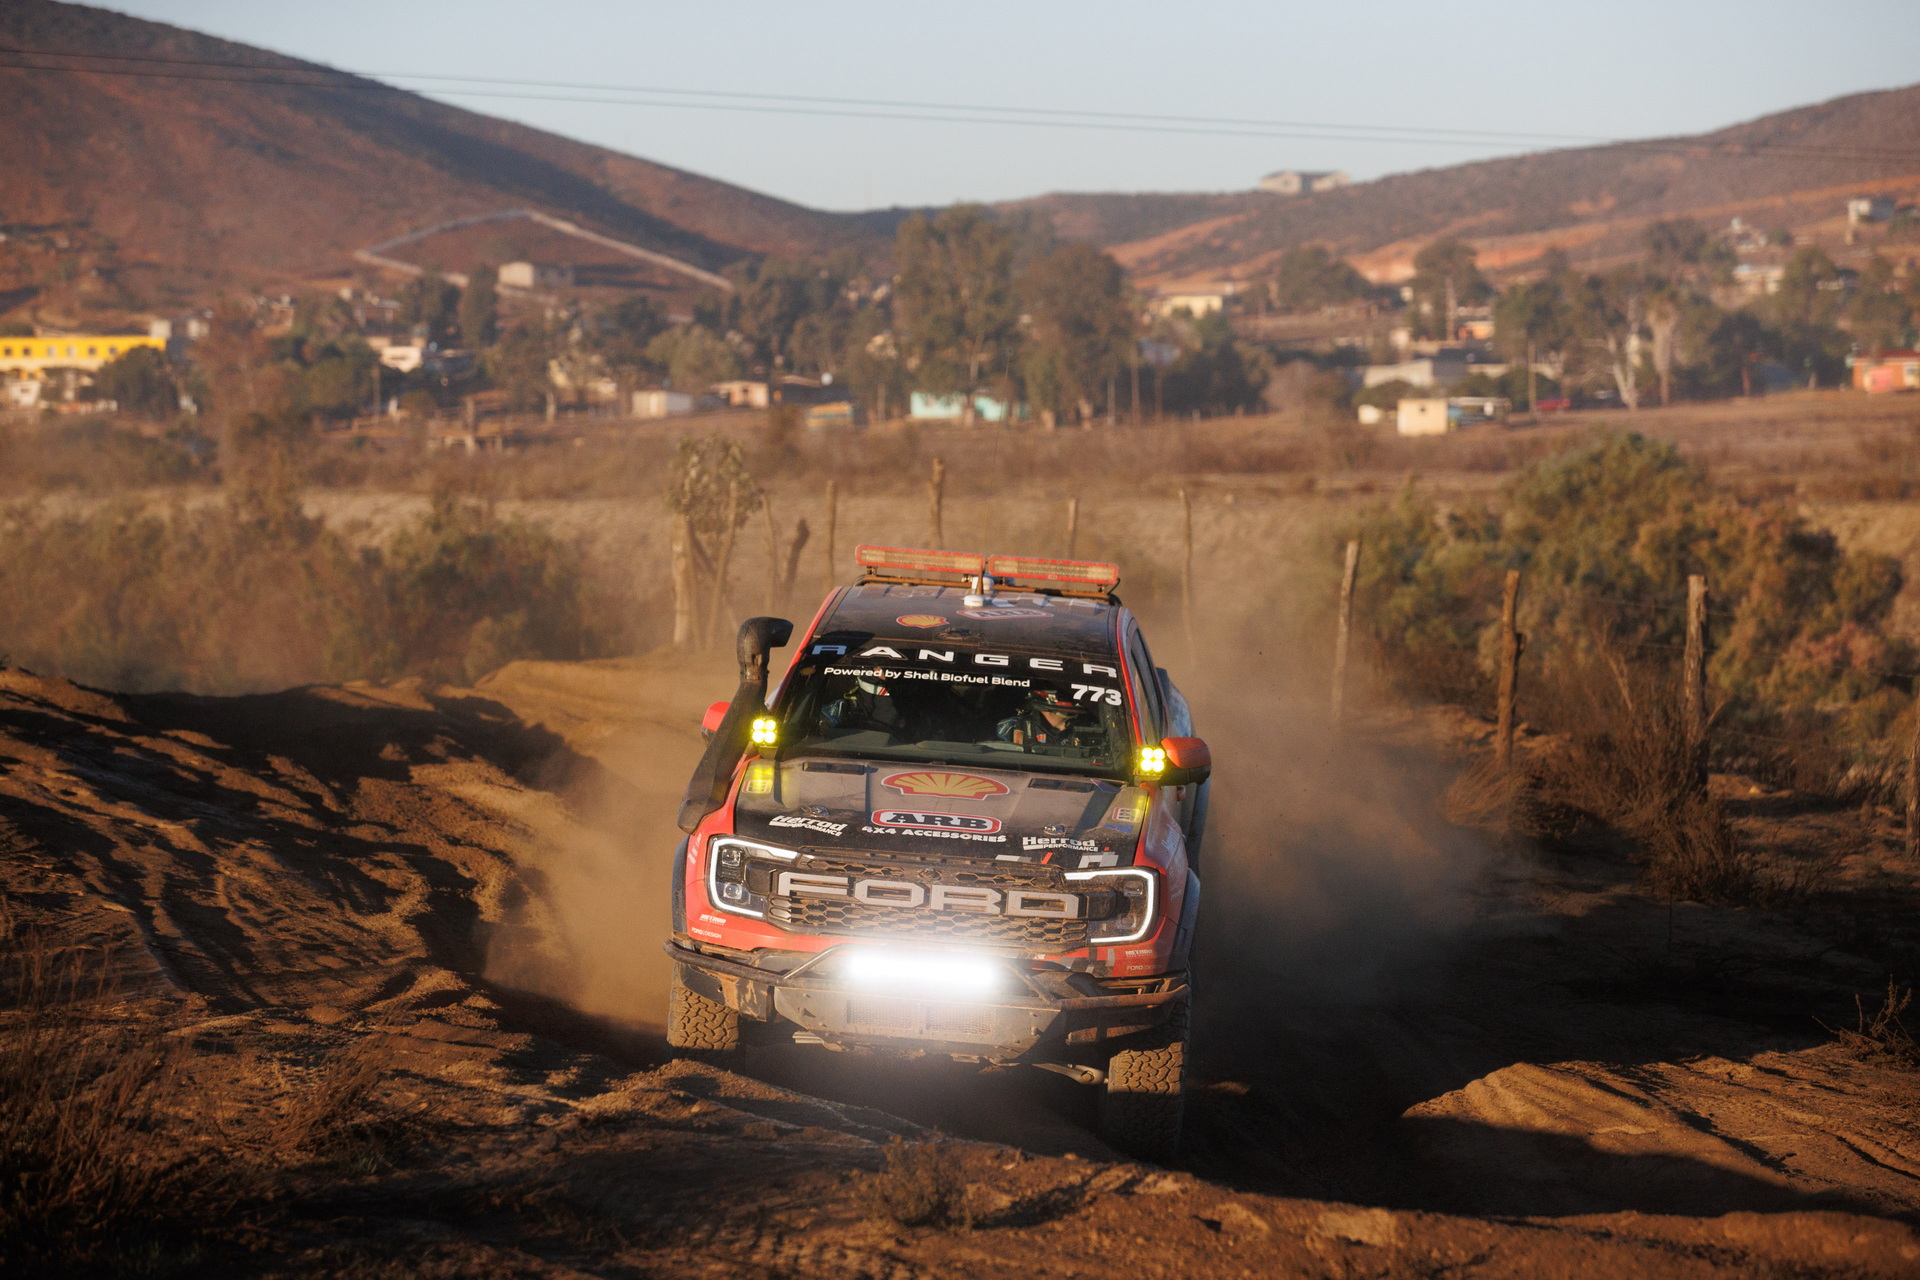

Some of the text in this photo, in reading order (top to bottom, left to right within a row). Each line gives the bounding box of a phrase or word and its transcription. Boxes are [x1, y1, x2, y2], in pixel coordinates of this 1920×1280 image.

[811, 645, 1117, 679] RANGER
[824, 667, 1031, 688] Powered by Shell Biofuel Blend
[1071, 683, 1122, 706] 773
[771, 815, 848, 831] Herrod
[787, 822, 843, 837] PERFORMANCE
[886, 812, 988, 830] ARB
[901, 828, 1007, 843] ACCESSORIES
[1022, 836, 1096, 847] Herrod
[1043, 843, 1099, 852] PERFORMANCE
[777, 871, 1080, 919] FORD
